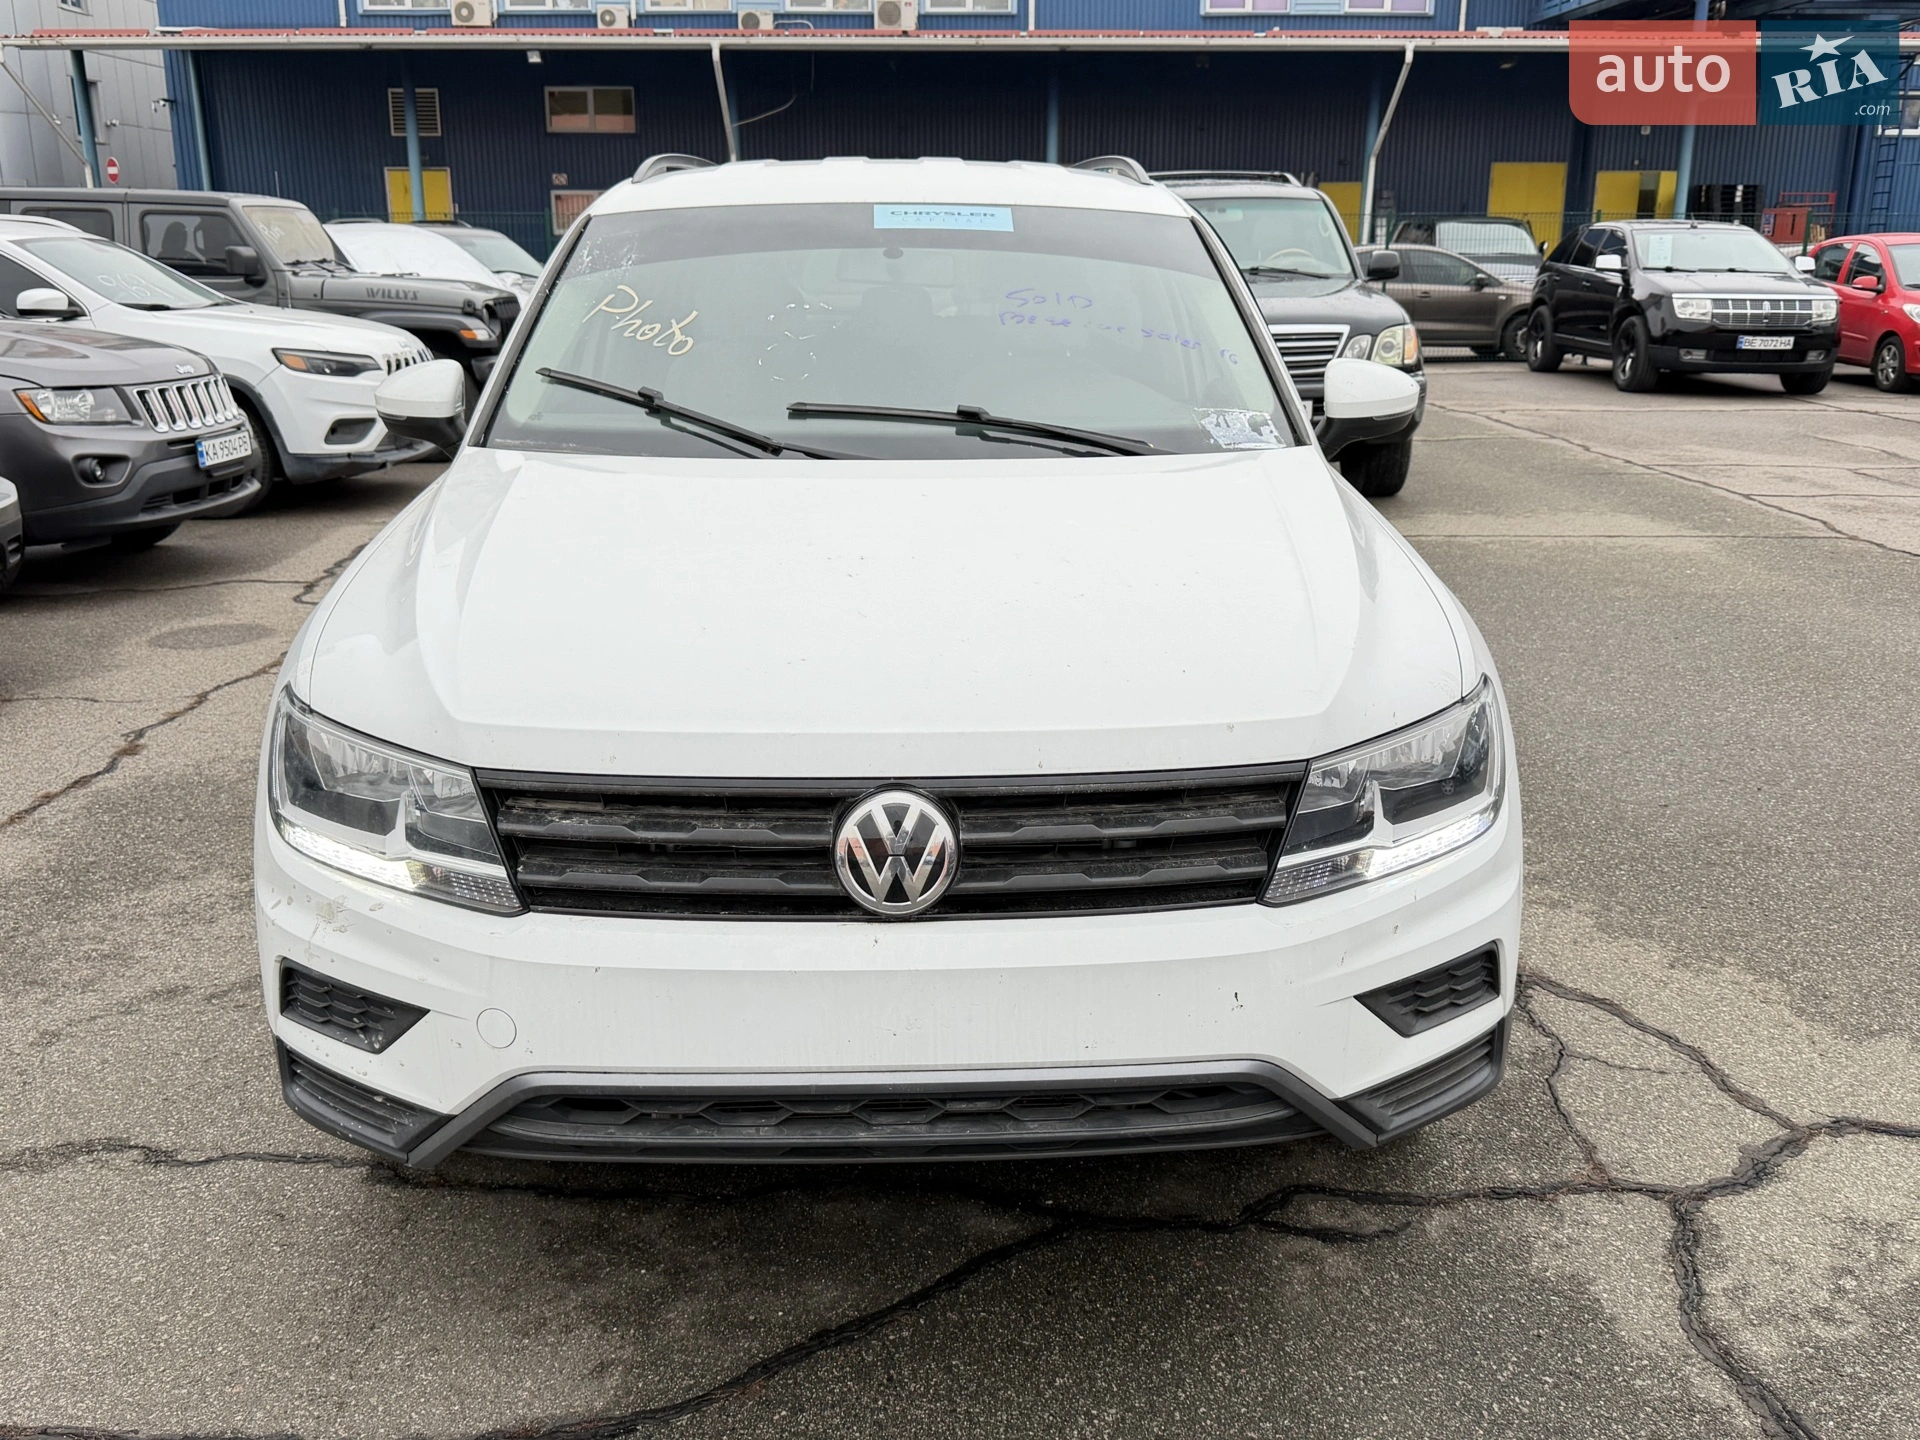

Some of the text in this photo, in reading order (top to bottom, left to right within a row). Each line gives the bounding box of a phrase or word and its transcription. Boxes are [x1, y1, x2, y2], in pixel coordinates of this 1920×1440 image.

[890, 210, 996, 218] CHRYSLER
[366, 287, 420, 301] WILLYS
[582, 284, 698, 356] Photo
